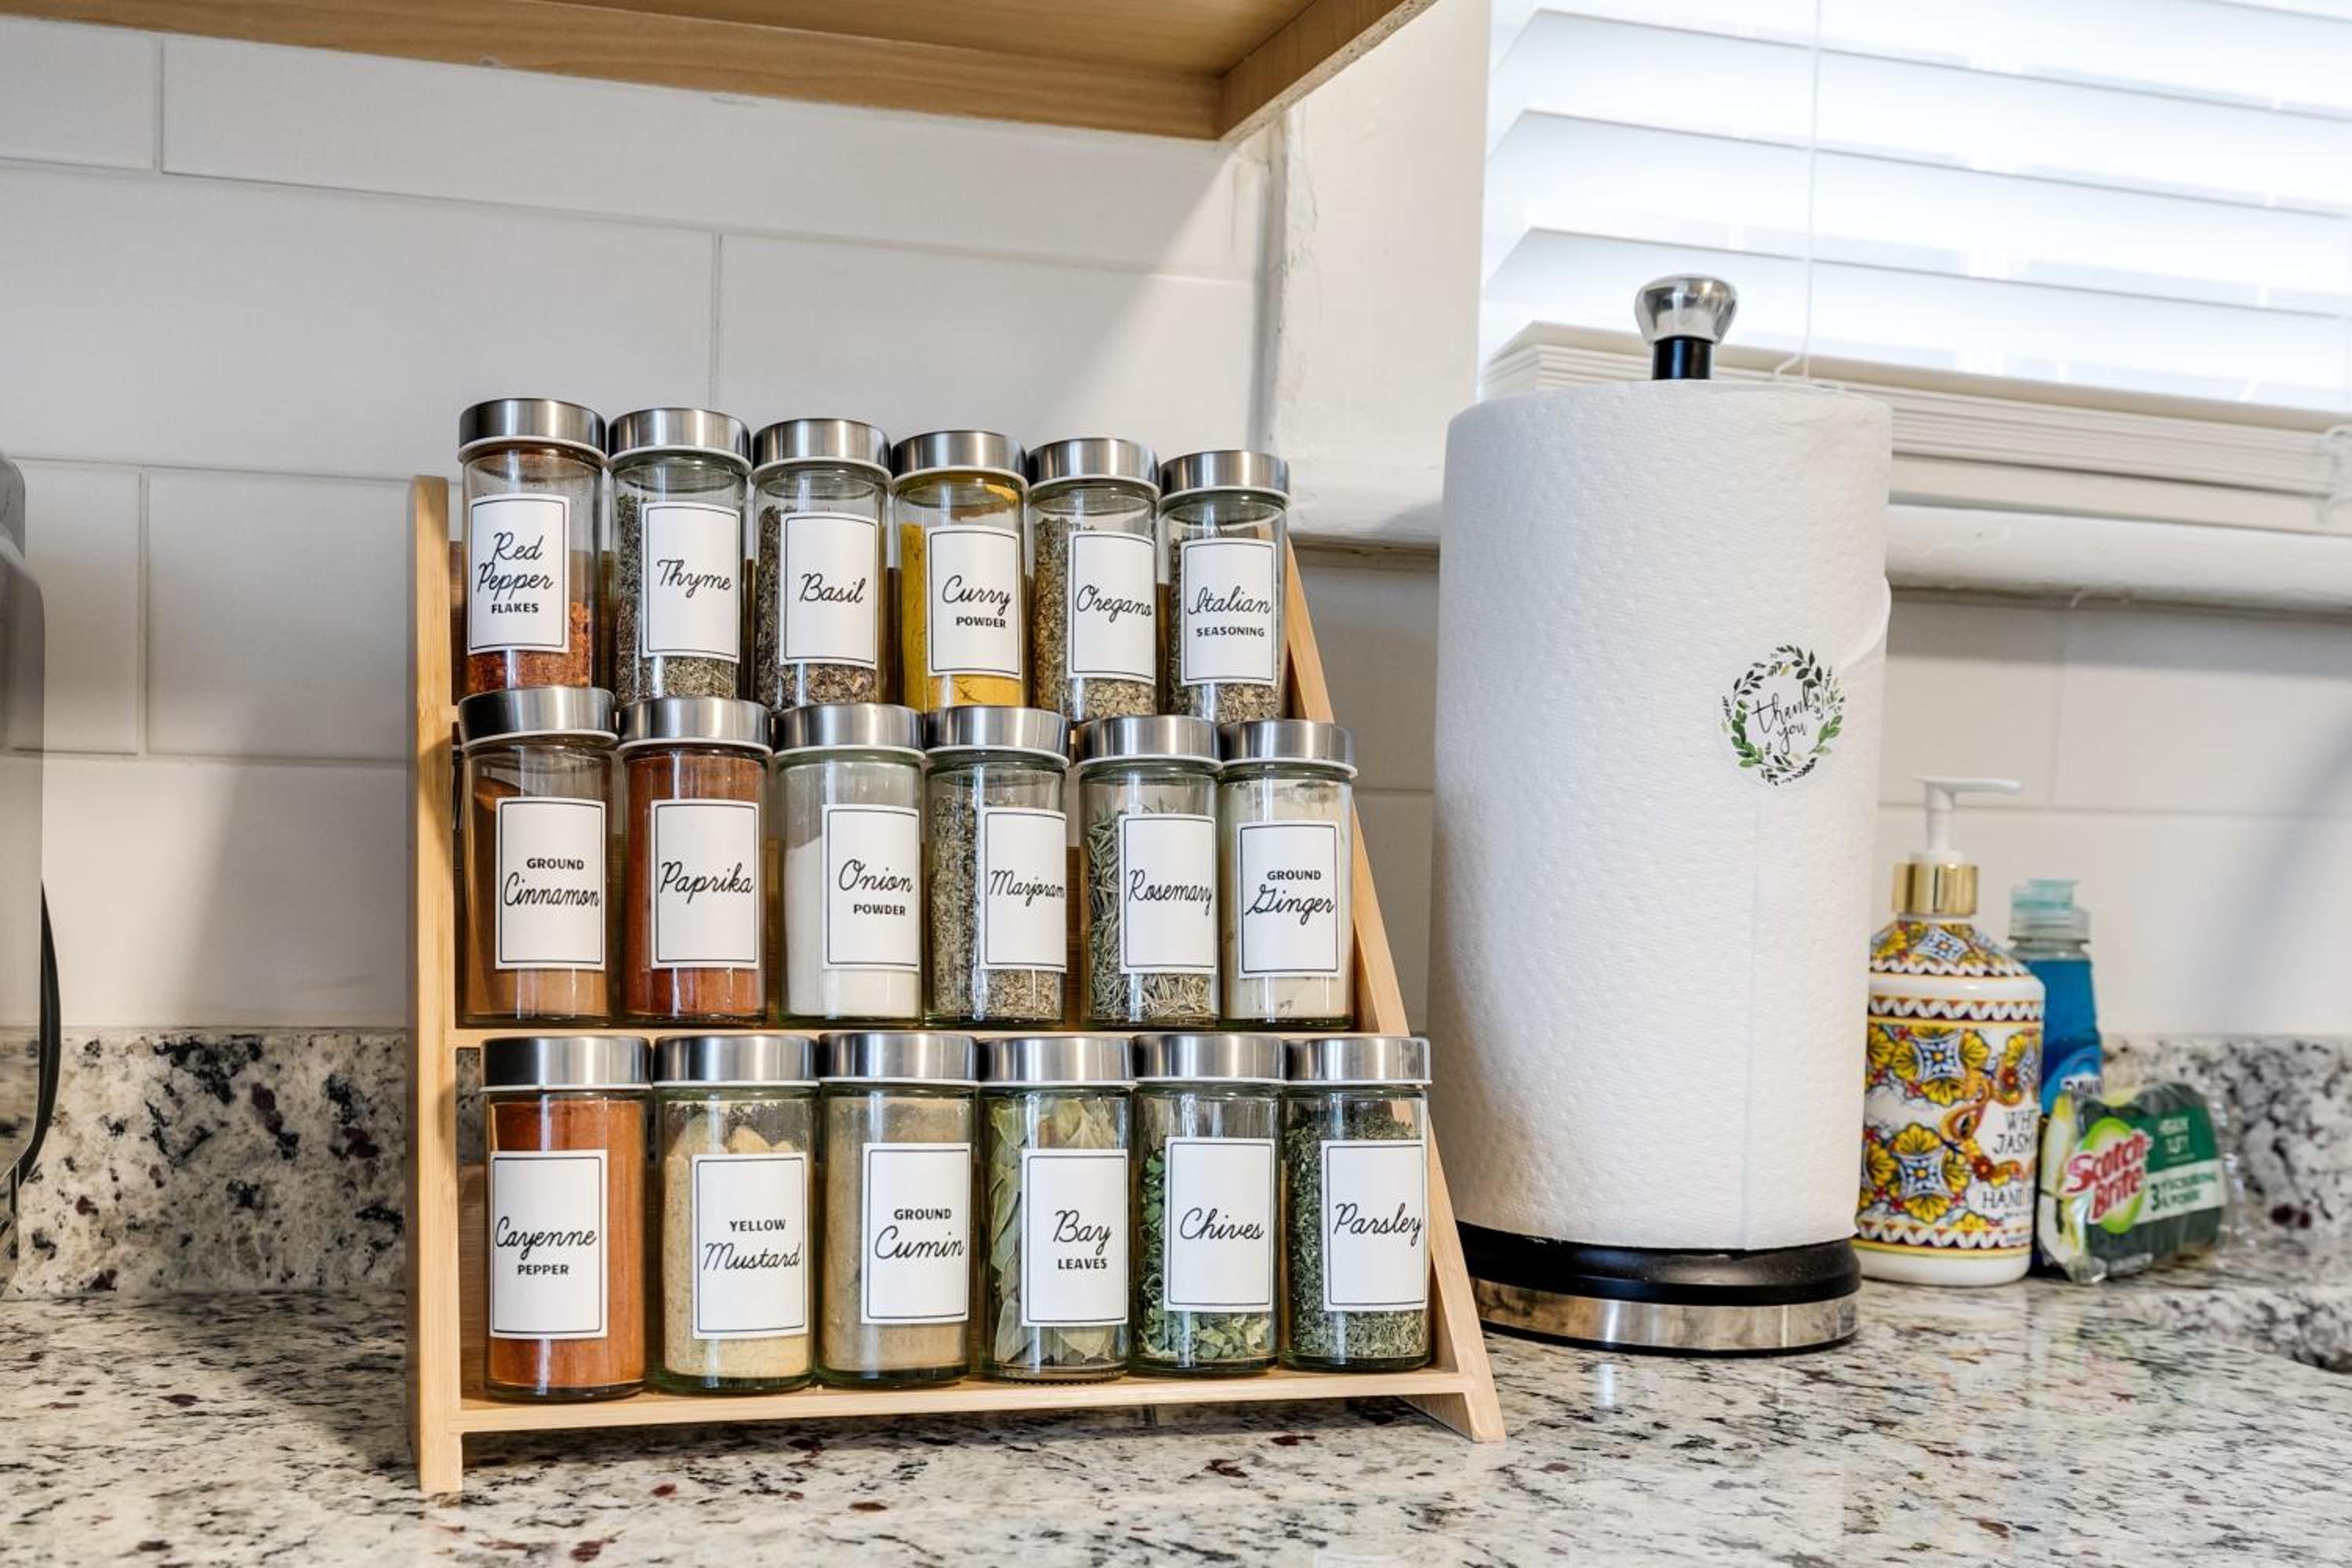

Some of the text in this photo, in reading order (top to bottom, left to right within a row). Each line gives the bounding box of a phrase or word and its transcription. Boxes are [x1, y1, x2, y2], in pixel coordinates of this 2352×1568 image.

[492, 532, 543, 563] Red
[476, 561, 554, 601] Pepper
[657, 559, 731, 598] Thyme
[799, 573, 866, 603] Basil
[491, 603, 539, 614] FLAKES
[942, 575, 1011, 617] Curry
[1076, 584, 1152, 623] Oregano
[1188, 586, 1271, 615] Italian
[956, 616, 1006, 628] POWDER
[1196, 626, 1265, 637] SEASONING
[1751, 682, 1813, 733] thank
[1777, 721, 1806, 754] you
[526, 858, 584, 870] GROUND
[838, 858, 912, 893] Onion
[1267, 870, 1321, 880] GROUND
[503, 871, 600, 907] Cinnamon
[659, 861, 753, 904] Paprika
[989, 870, 1064, 907] Marjoram
[1128, 869, 1213, 916] Rosemary
[853, 904, 906, 916] POWDER
[1244, 884, 1334, 926] Ginger
[2092, 1167, 2142, 1219] Brite
[2150, 1182, 2161, 1212] 3
[730, 1220, 785, 1232] YELLOW
[894, 1208, 951, 1221] GROUND
[1180, 1207, 1265, 1240] Chives
[1334, 1203, 1421, 1247] Parsley
[495, 1215, 597, 1261] Cayenne
[874, 1225, 964, 1259] Cumin
[1053, 1210, 1111, 1256] Bay
[517, 1264, 568, 1276] PEPPER
[703, 1243, 799, 1270] Mustard
[1058, 1258, 1107, 1269] LEAVES
